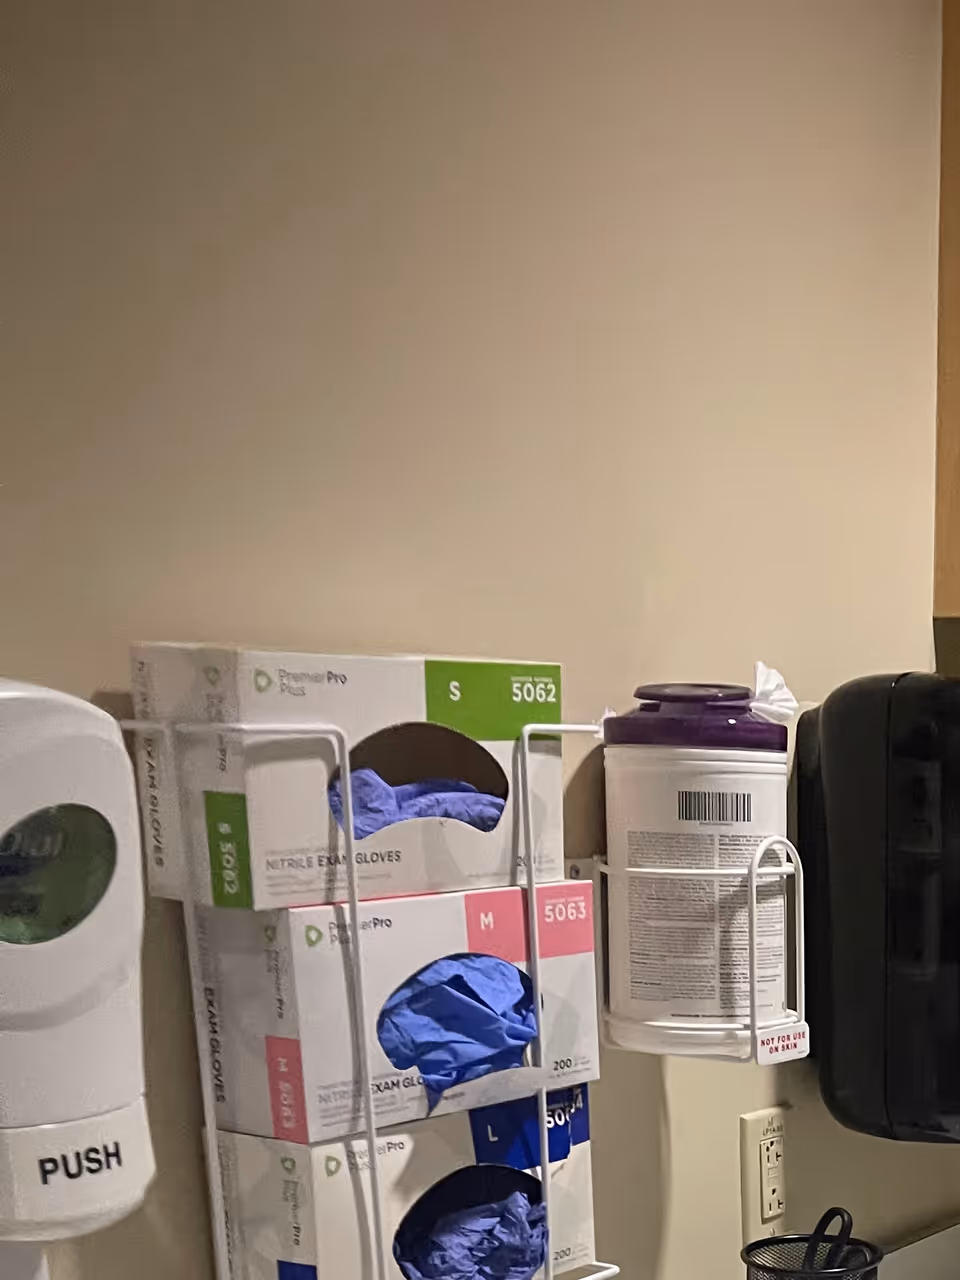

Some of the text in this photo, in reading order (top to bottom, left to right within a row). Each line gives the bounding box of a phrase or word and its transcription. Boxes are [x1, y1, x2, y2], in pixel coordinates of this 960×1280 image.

[449, 680, 461, 702] S
[512, 682, 556, 703] 5062
[355, 850, 402, 865] GLOVES
[480, 911, 494, 930] M
[544, 902, 586, 922] 5063
[204, 988, 219, 1034] EXAM
[760, 1031, 806, 1047] NOT FOR USE
[769, 1045, 779, 1054] ON
[781, 1042, 797, 1052] SKIN
[210, 1038, 227, 1104] GLOVES
[552, 1058, 573, 1071] 200
[402, 1076, 424, 1089] GLO
[487, 1124, 499, 1142] L
[38, 1140, 122, 1186] PUSH
[553, 1247, 571, 1261] 200
